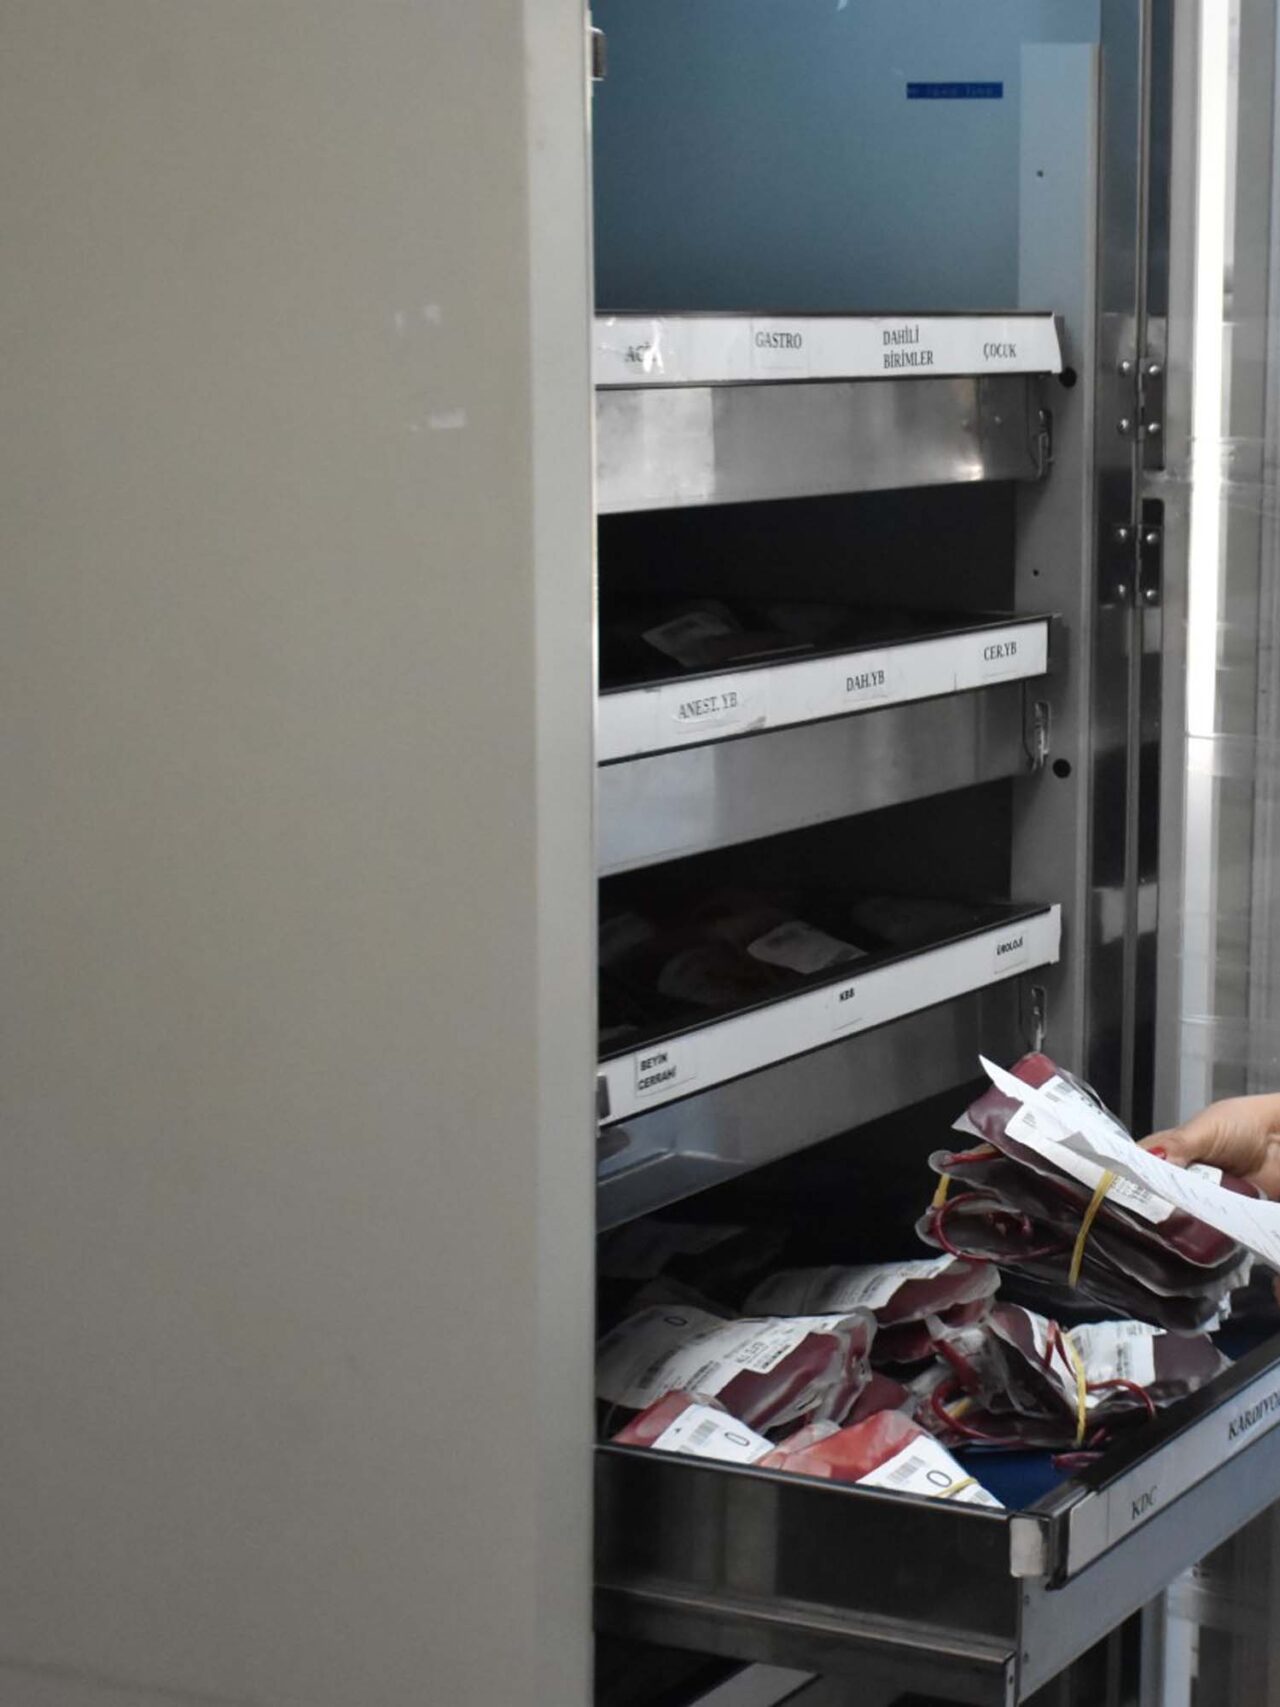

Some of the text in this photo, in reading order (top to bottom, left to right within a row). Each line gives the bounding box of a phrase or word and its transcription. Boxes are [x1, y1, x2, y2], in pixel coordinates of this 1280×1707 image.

[755, 331, 802, 349] GASTRO
[883, 325, 919, 345] DAHİLİ
[883, 349, 933, 369] BİRİMLER
[983, 342, 1016, 361] ÇOCUK
[721, 691, 737, 709] YB
